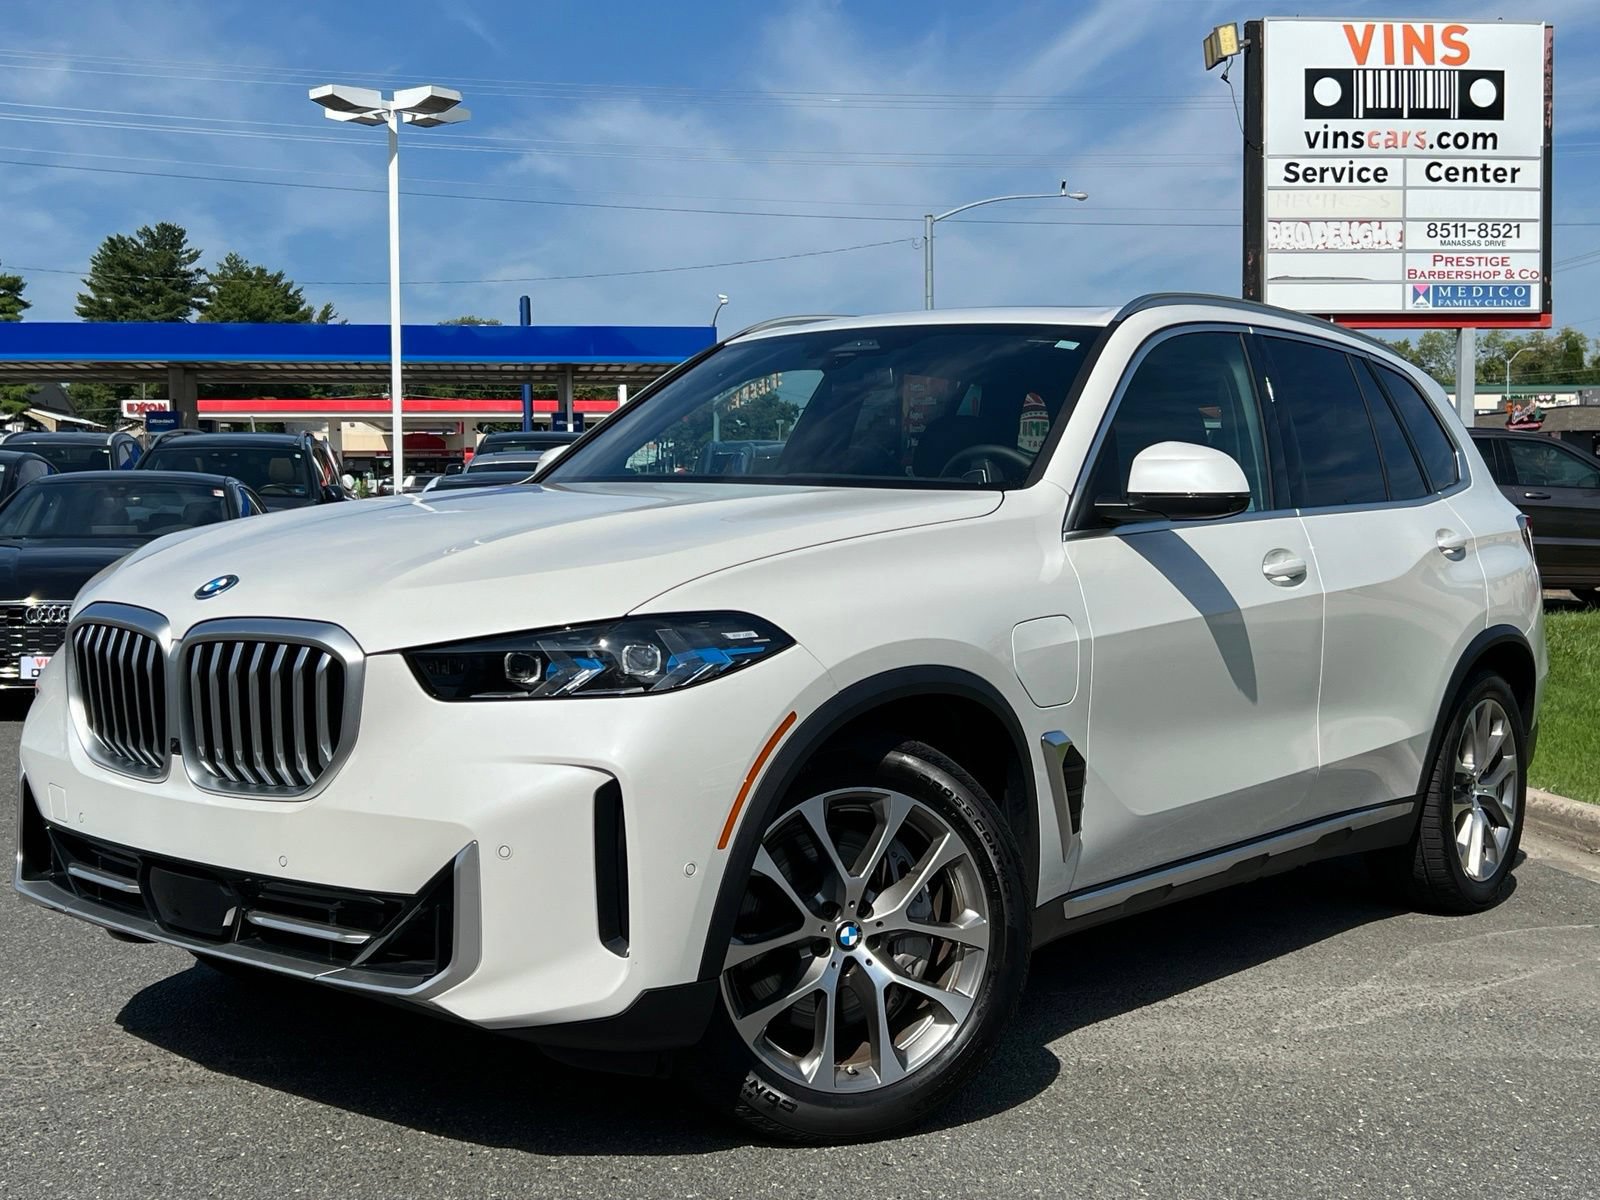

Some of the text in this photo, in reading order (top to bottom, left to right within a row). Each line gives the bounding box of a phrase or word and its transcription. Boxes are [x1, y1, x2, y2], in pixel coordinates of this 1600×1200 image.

[1342, 23, 1471, 66] VINS
[1304, 124, 1498, 150] vinscars.com
[1283, 160, 1521, 184] Service Center
[1426, 222, 1521, 239] 8511-8521
[1432, 254, 1511, 267] PRESTIGE
[1407, 268, 1501, 280] BARBERSHOP
[1504, 268, 1515, 280] &
[1438, 286, 1526, 298] MEDICO
[1438, 299, 1526, 307] FAMILY CLINIC
[126, 402, 167, 414] EXXON
